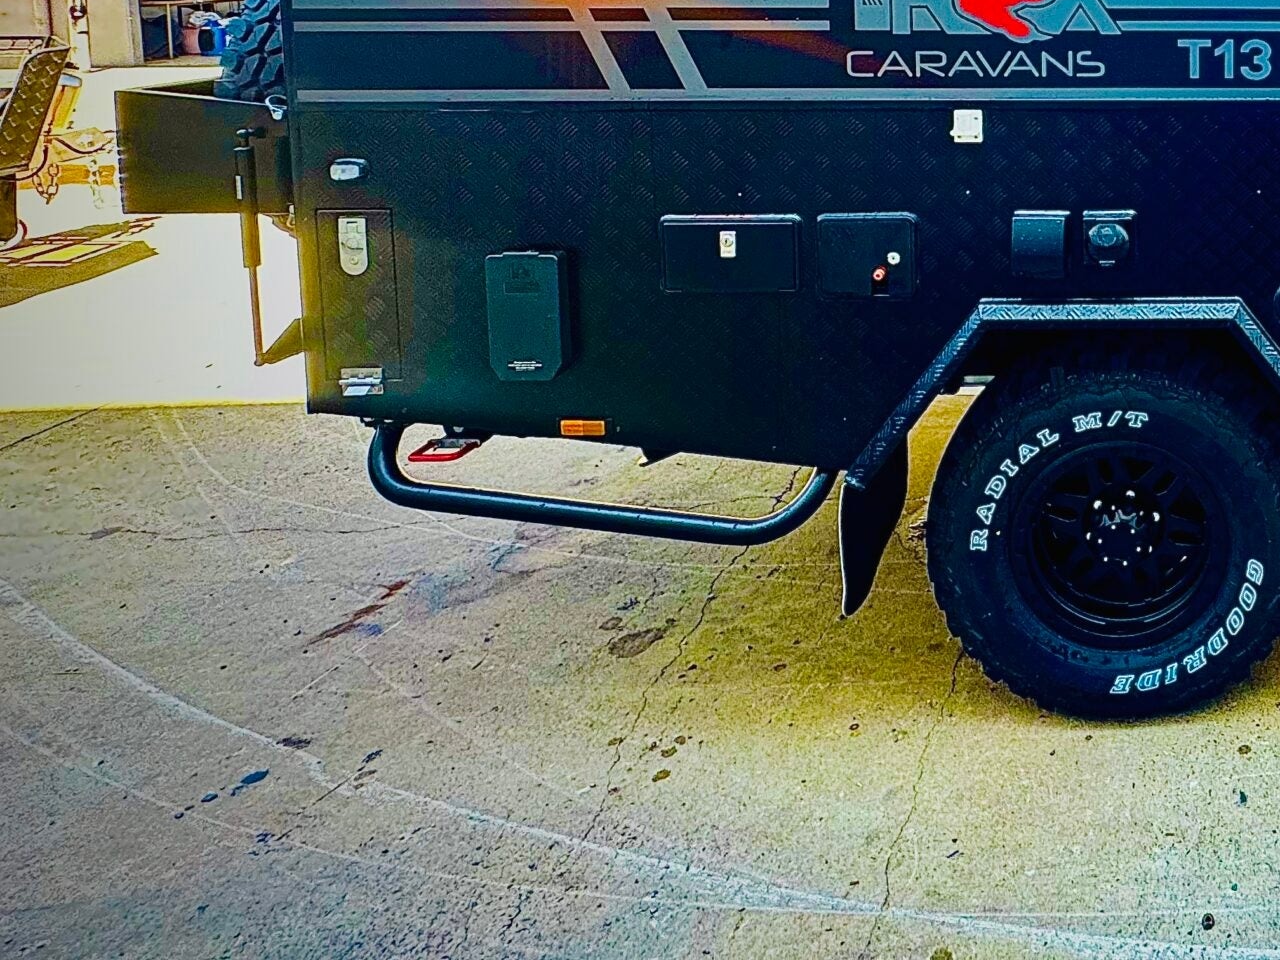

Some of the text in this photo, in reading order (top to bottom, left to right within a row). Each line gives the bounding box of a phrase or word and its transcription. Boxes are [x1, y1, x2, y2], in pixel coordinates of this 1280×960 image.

[846, 50, 1106, 77] CARAVANS
[1177, 38, 1272, 81] T13
[970, 410, 1149, 551] RADIAL M/T
[1109, 558, 1264, 694] GOODRIDE
